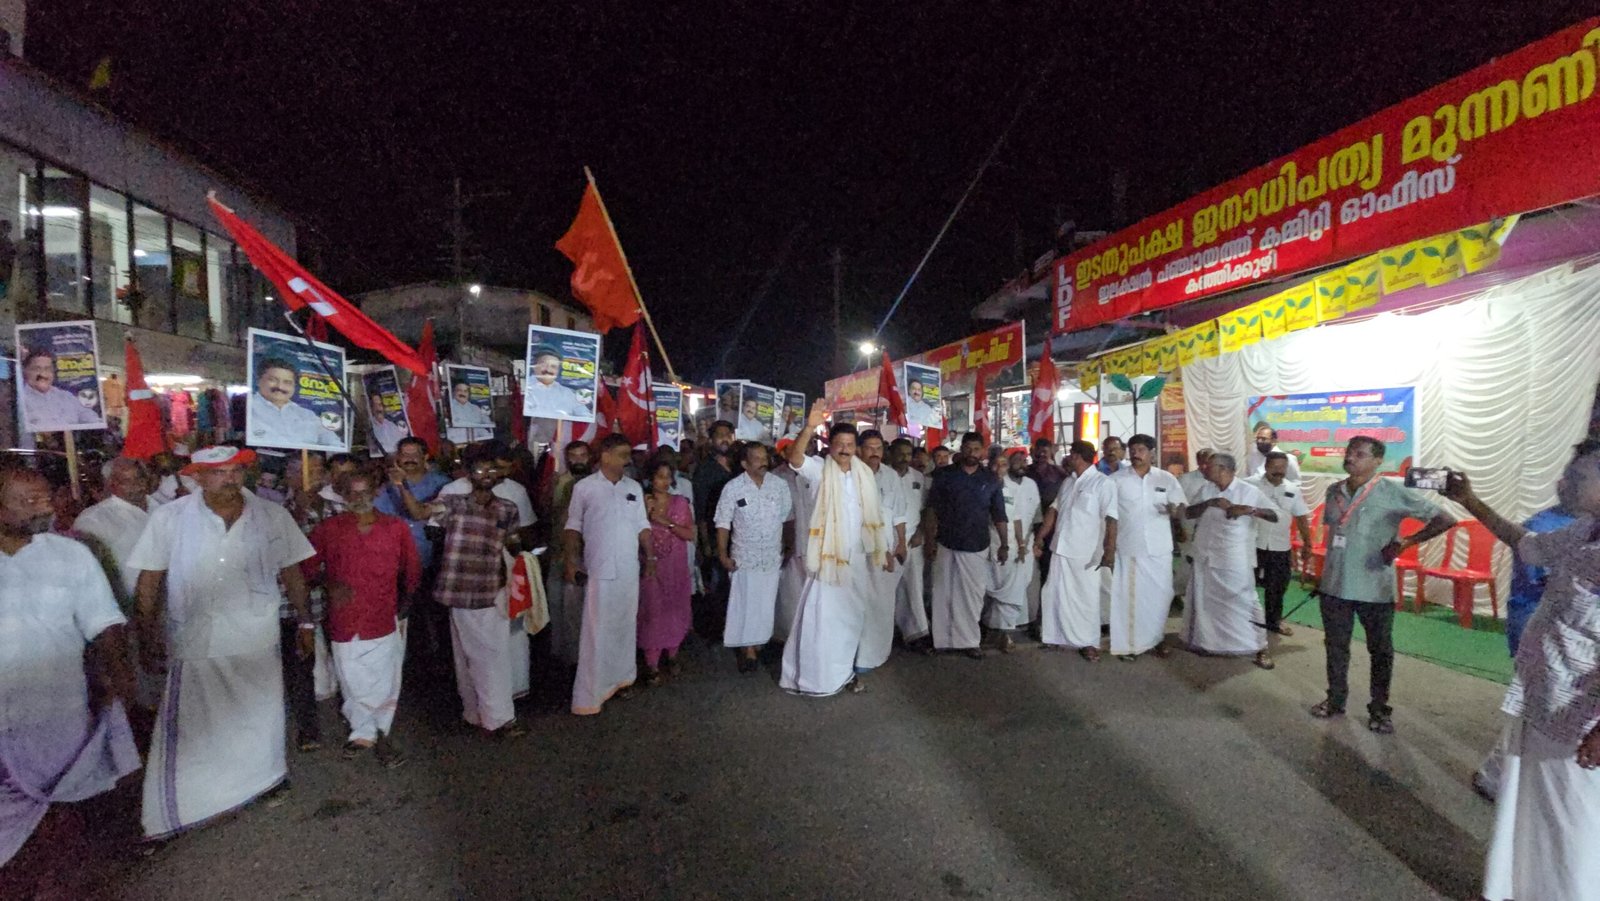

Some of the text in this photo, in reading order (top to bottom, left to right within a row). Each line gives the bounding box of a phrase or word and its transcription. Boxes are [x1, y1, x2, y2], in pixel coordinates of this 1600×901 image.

[1076, 220, 1183, 290] ഇടതുപക്ഷ
[1193, 133, 1383, 247] ജനാധിപത്യ
[1340, 155, 1462, 225] ഓഫീസ്
[1057, 264, 1073, 329] LDF
